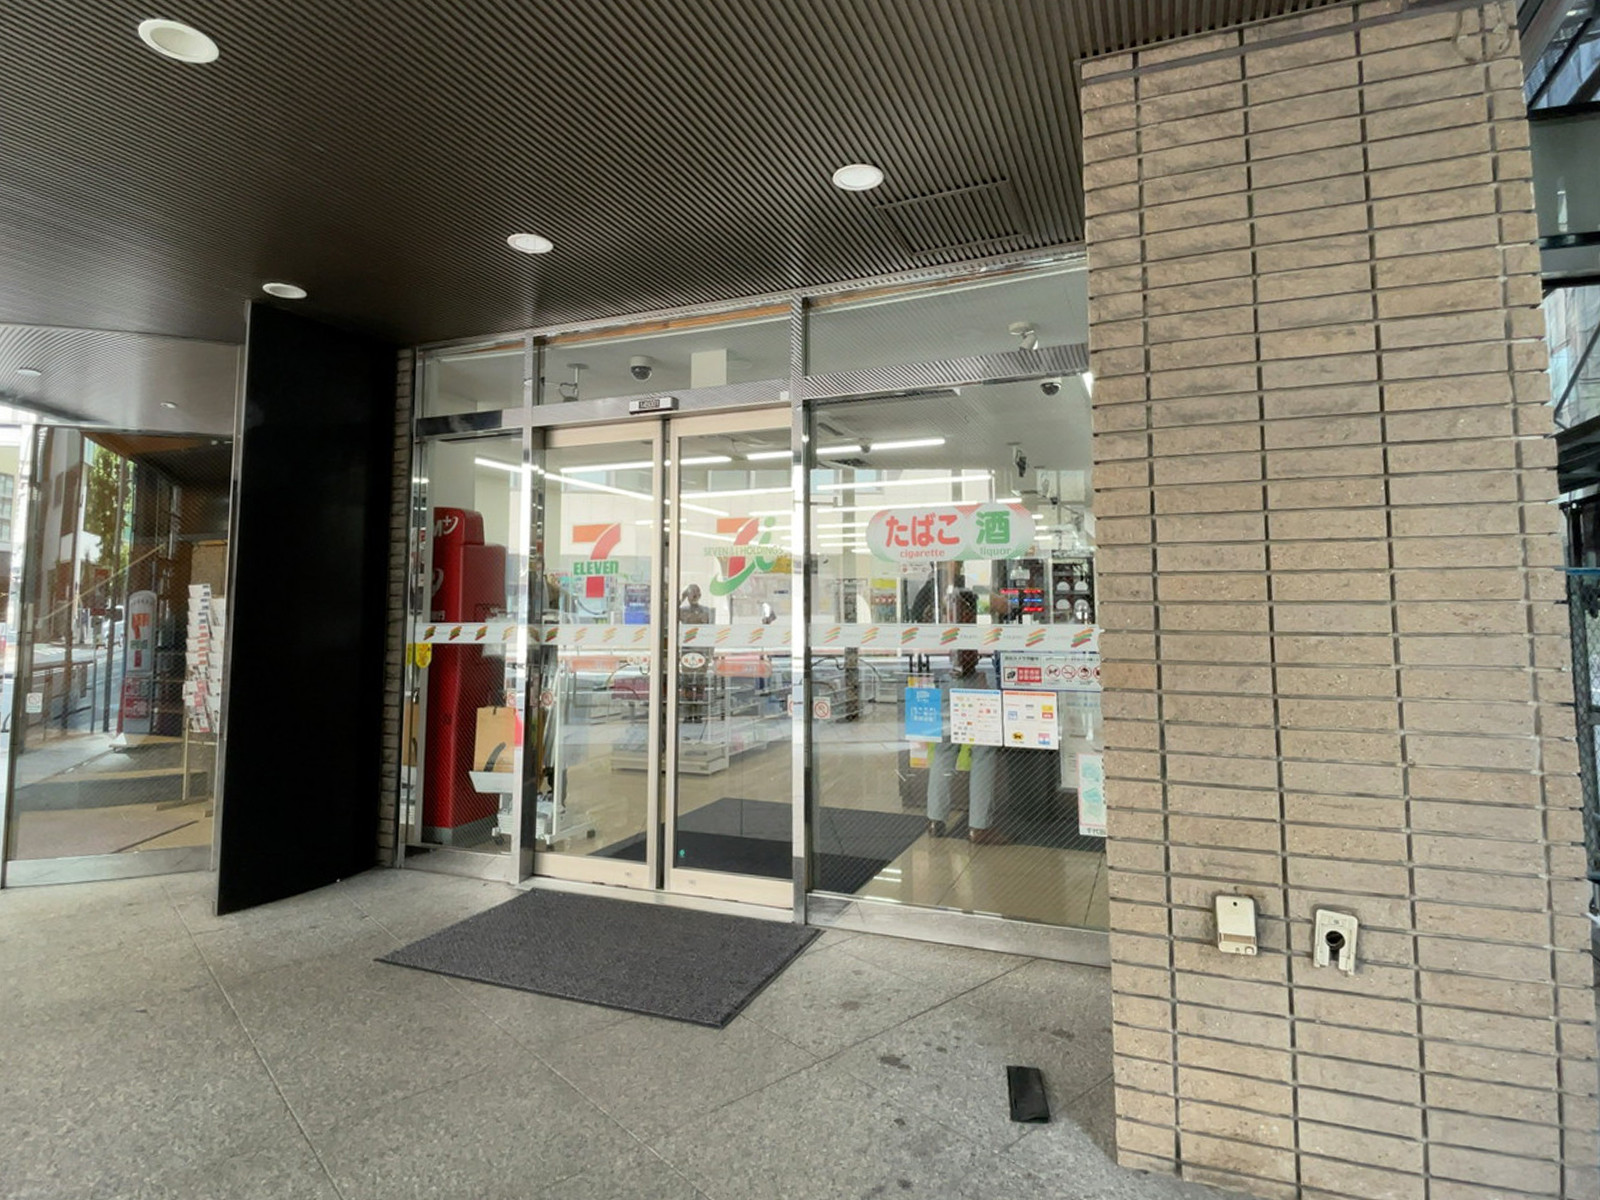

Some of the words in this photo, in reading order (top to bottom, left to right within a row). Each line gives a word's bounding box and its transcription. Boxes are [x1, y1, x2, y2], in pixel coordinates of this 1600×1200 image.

[885, 513, 960, 547] たばこ
[976, 511, 1010, 544] 酒
[572, 523, 621, 598] 7
[900, 549, 945, 559] cigarette
[981, 547, 1012, 557] liquor
